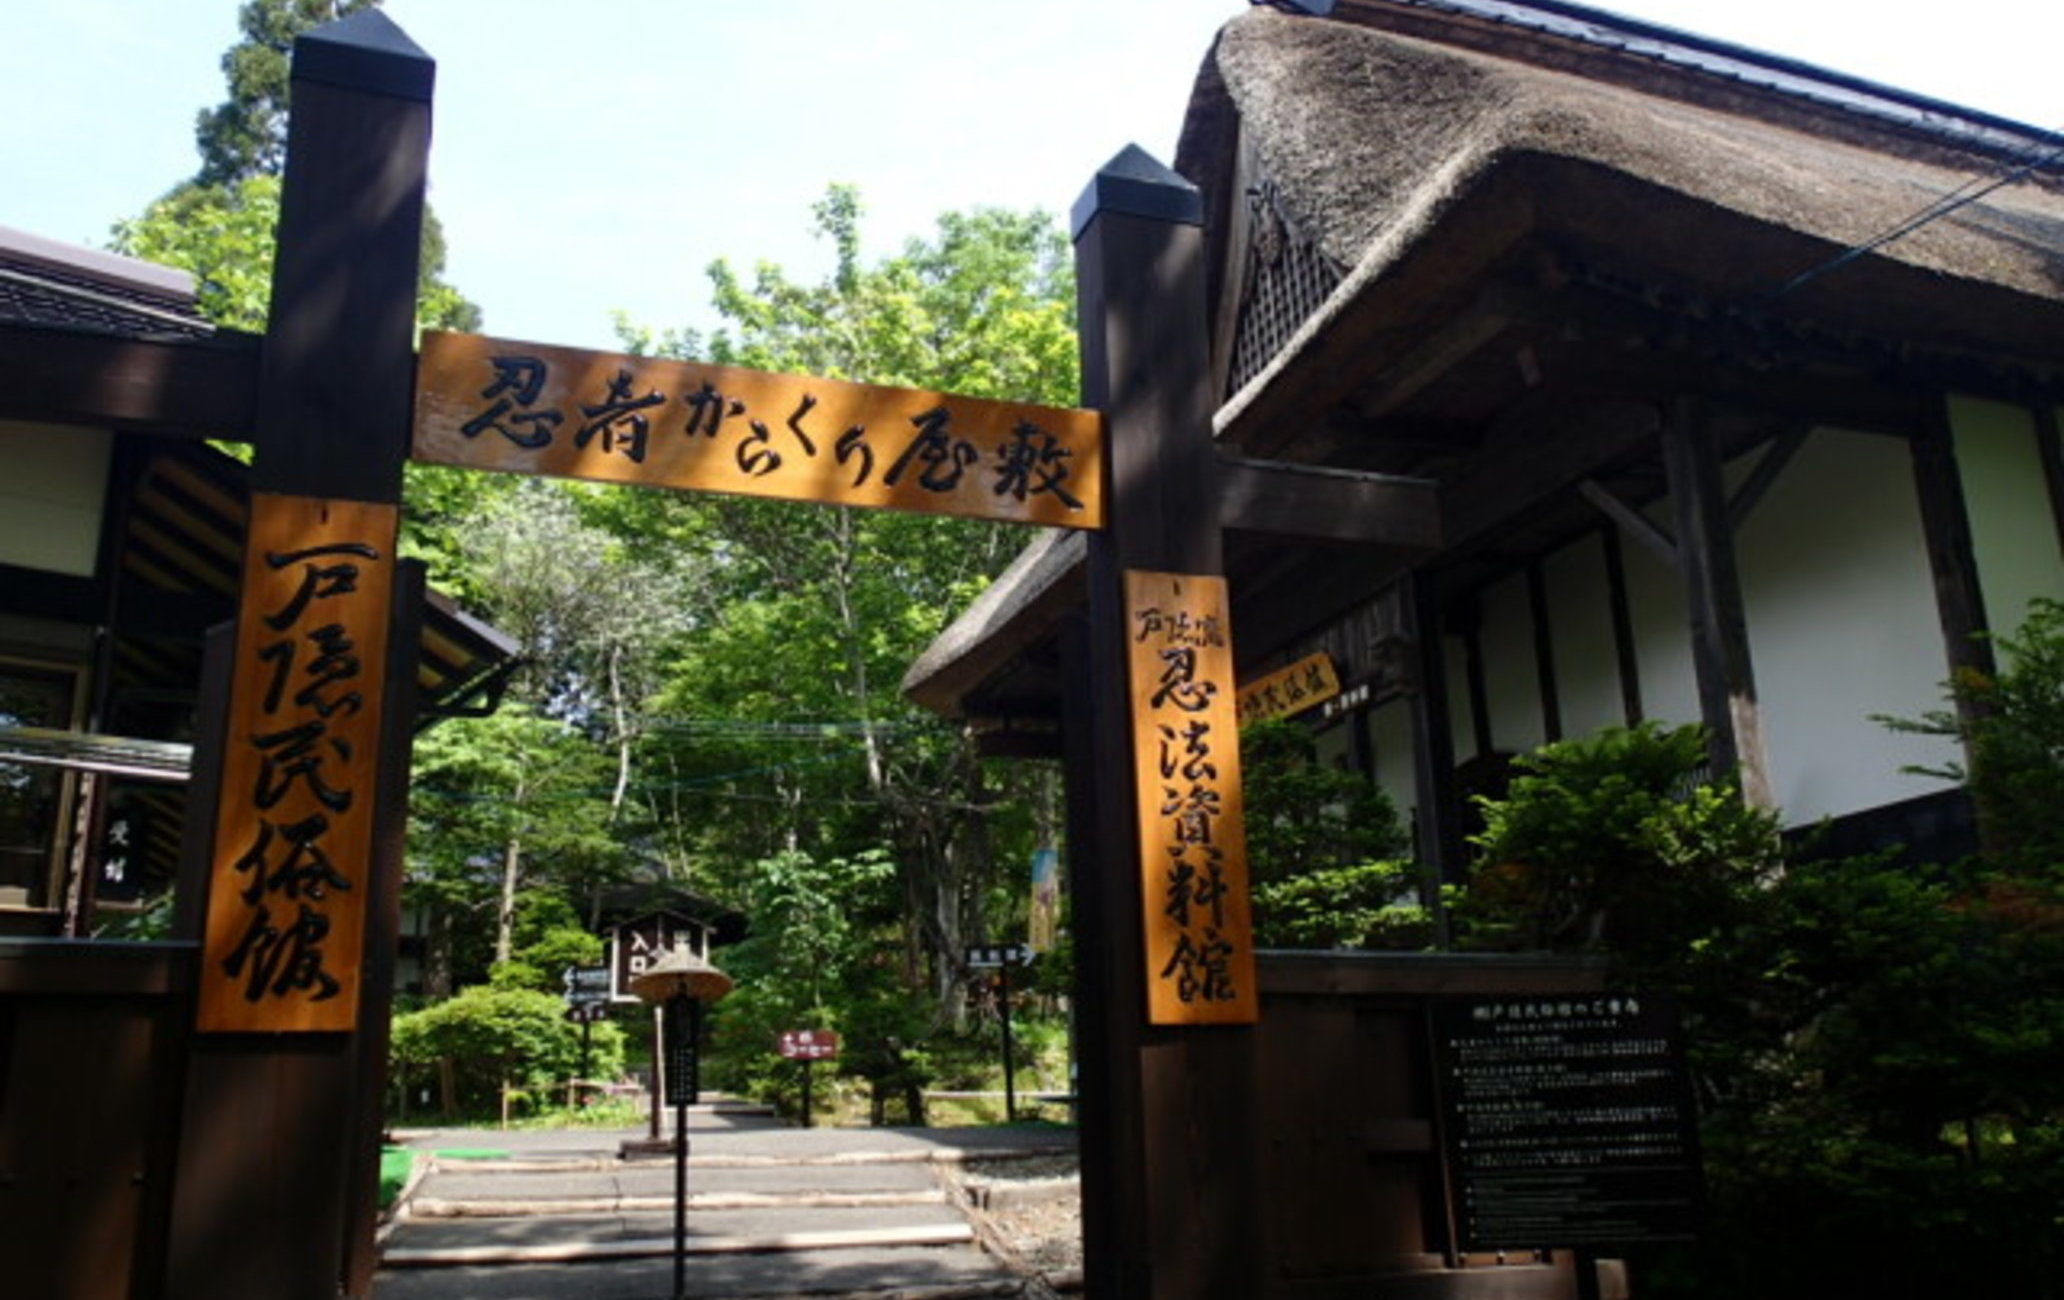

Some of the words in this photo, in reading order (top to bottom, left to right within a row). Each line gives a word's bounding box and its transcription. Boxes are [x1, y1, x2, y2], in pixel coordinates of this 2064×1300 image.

[459, 355, 1085, 510] 忍者からくり屋敷
[1150, 647, 1236, 1004] 忍法資料館
